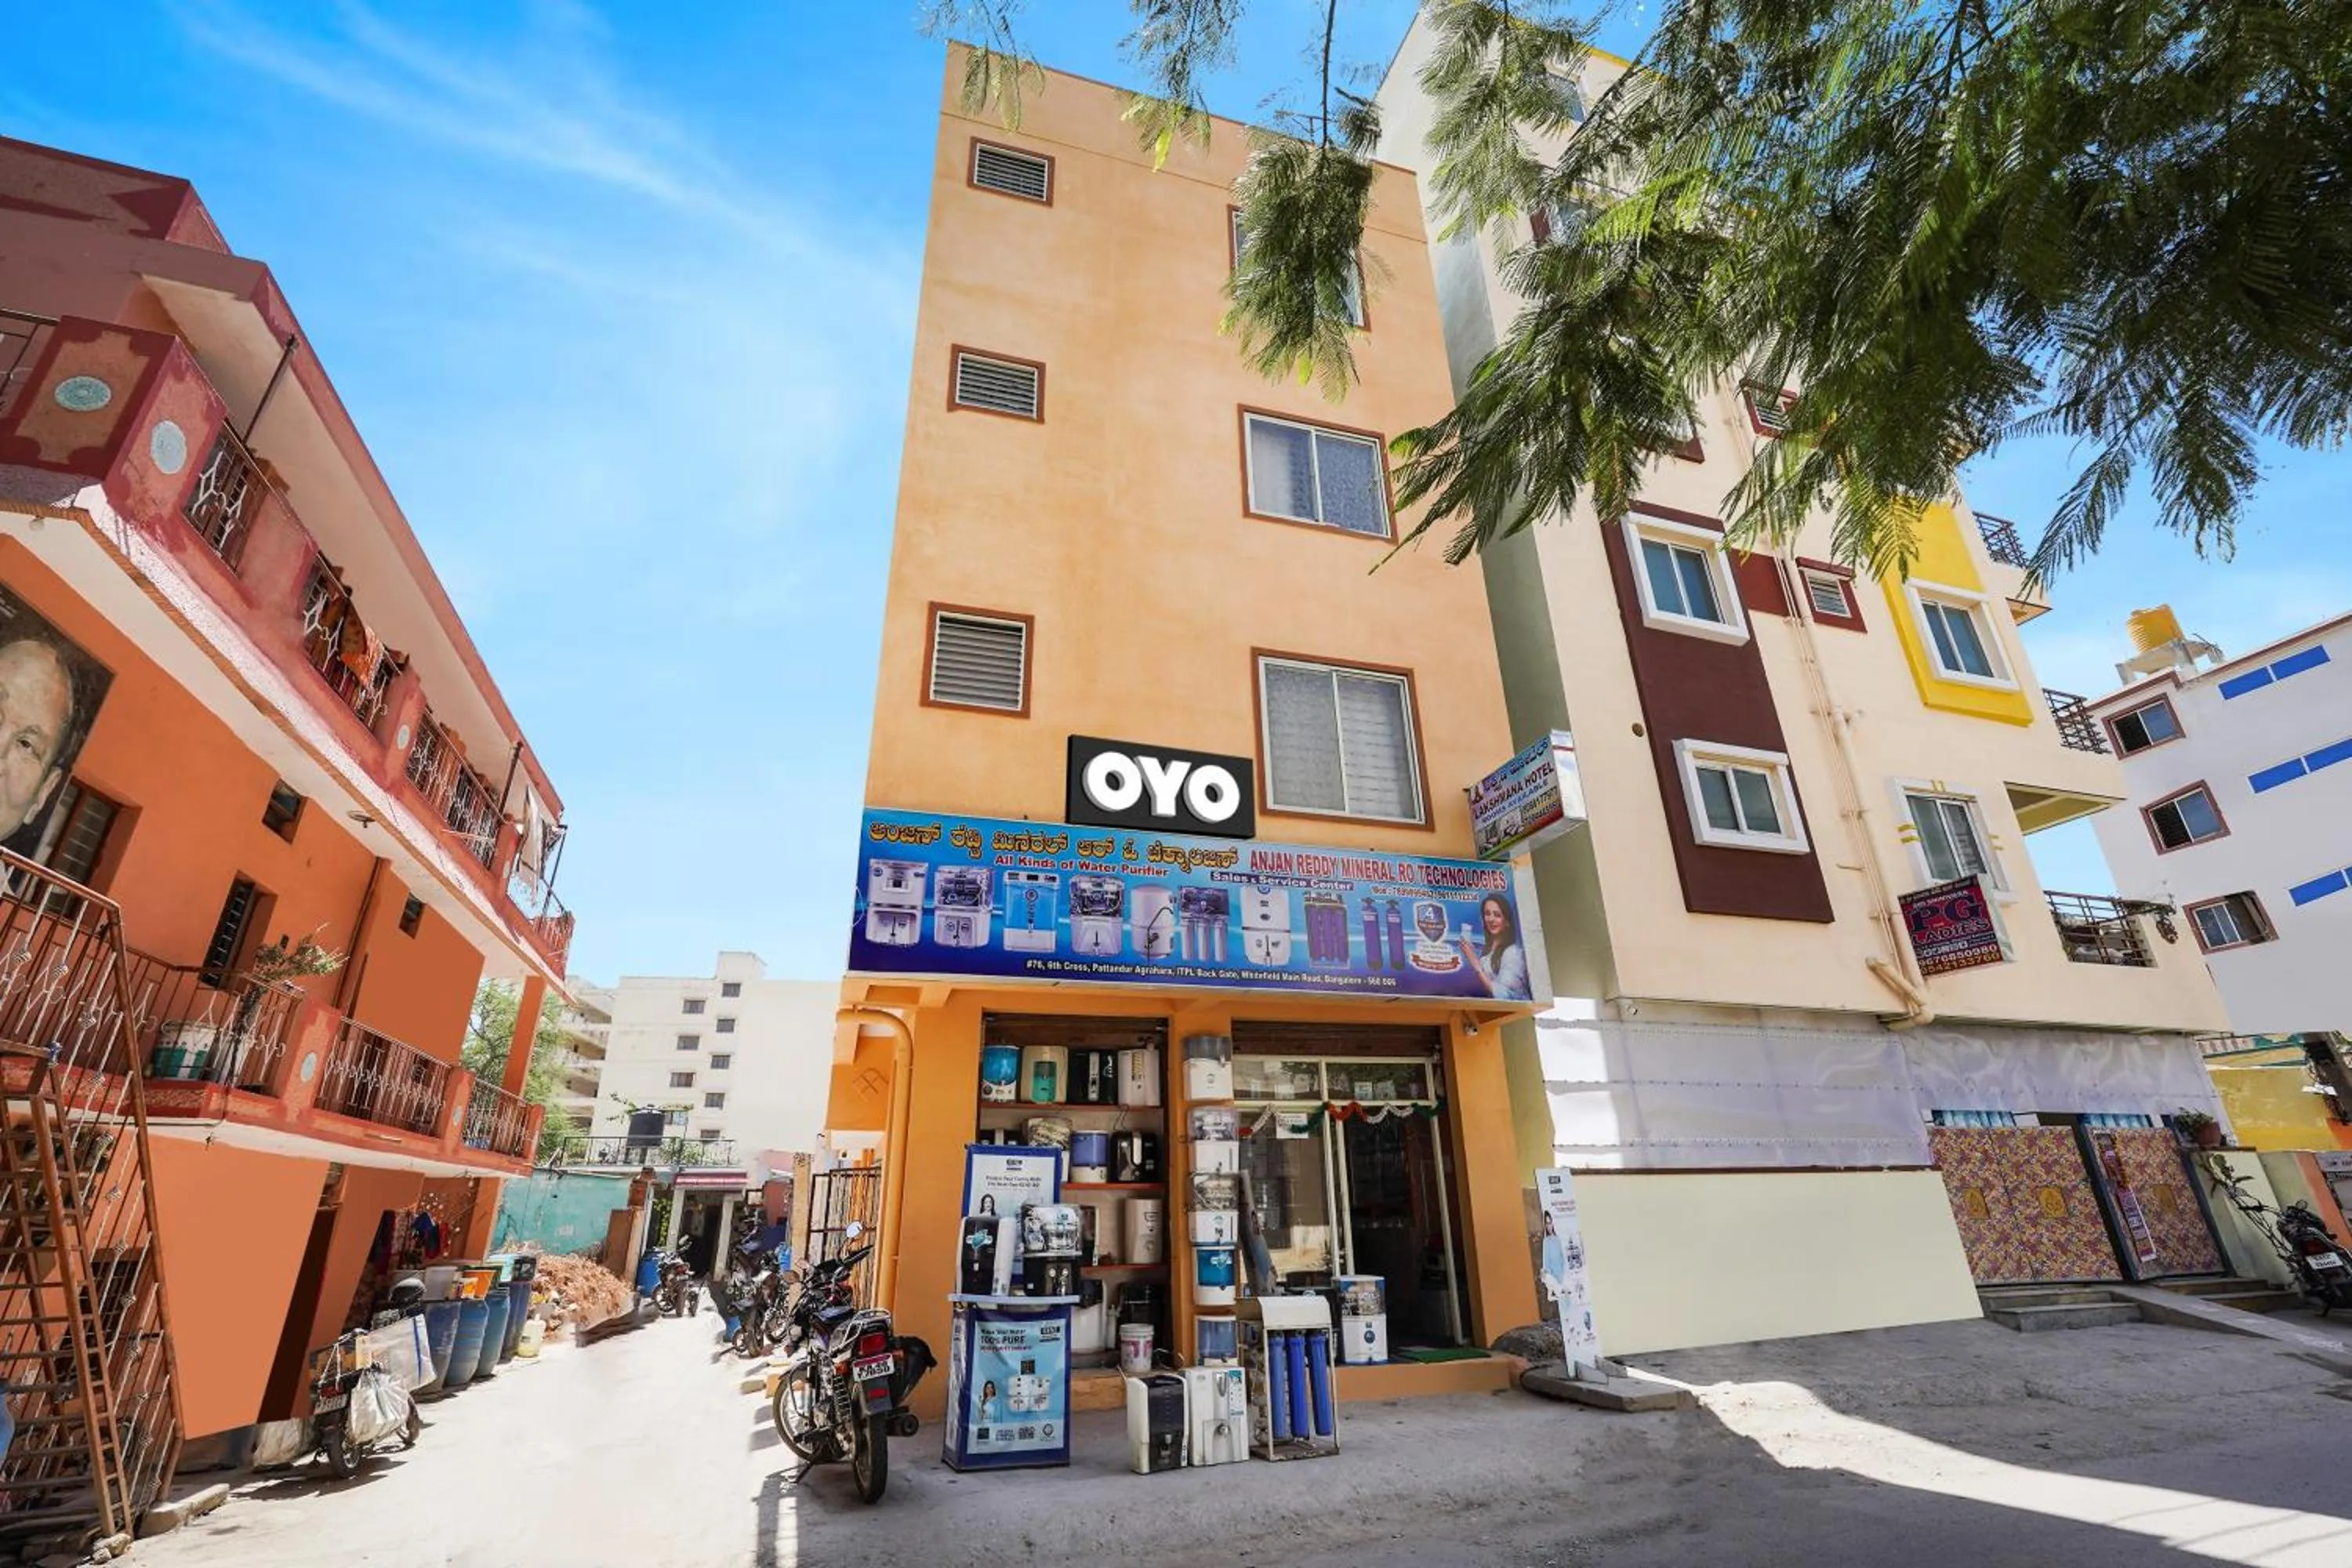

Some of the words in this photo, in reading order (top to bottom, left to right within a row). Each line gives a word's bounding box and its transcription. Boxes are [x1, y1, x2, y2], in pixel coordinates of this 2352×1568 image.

[1082, 751, 1240, 824] OYO
[1525, 762, 1554, 789] HOTEL
[995, 855, 1013, 866] All
[1019, 856, 1057, 869] Kinds
[1061, 860, 1073, 870] of
[1078, 861, 1117, 873] Water
[1122, 865, 1170, 877] Purifier
[1250, 849, 1292, 873] ANJAN
[1296, 852, 1338, 877] REDDY
[1341, 856, 1396, 881] MINERAL
[1417, 865, 1507, 890] TECHNOLOGIES
[1212, 872, 1249, 883] Sales
[1258, 875, 1307, 887] Service
[1310, 880, 1352, 891] Center
[1911, 918, 1991, 946] LADIES
[1064, 961, 1091, 972] Cross,
